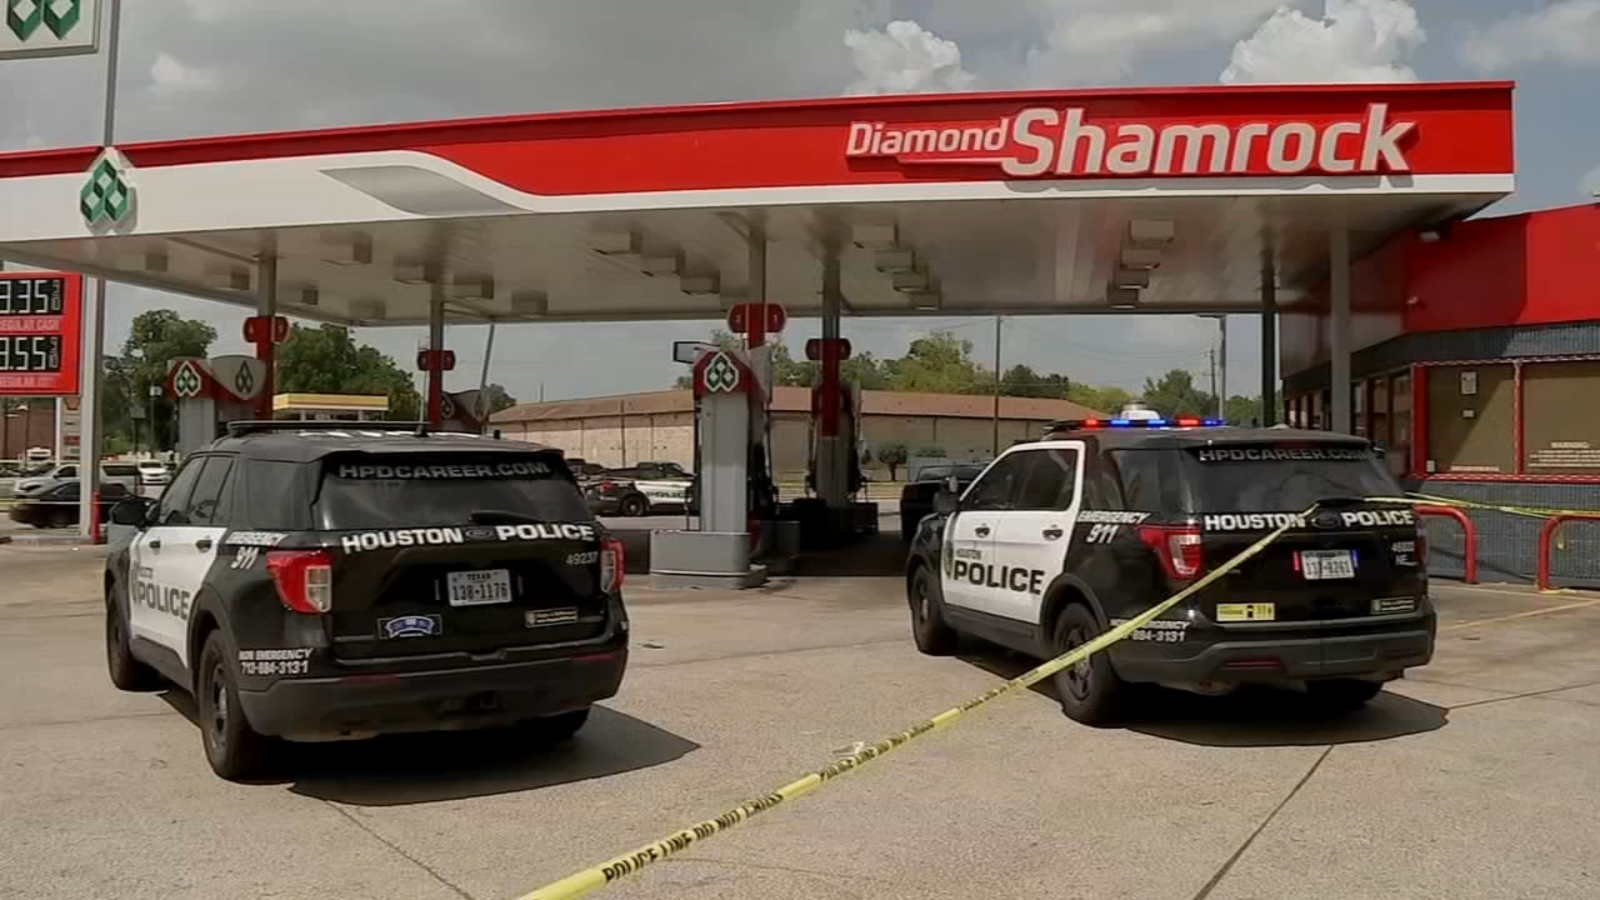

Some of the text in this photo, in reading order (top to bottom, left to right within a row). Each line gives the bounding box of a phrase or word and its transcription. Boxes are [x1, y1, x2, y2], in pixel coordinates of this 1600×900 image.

[846, 102, 1416, 176] Diamond Shamrock
[338, 460, 550, 479] HPDCAREER.COM
[1078, 510, 1152, 524] EMERGENCY
[1204, 509, 1415, 531] HOUSTON POLICE
[341, 523, 596, 554] HOUSTON POLICE
[1085, 523, 1119, 544] 911
[230, 546, 260, 570] 911
[953, 559, 1045, 596] POLICE
[137, 580, 191, 621] POLICE
